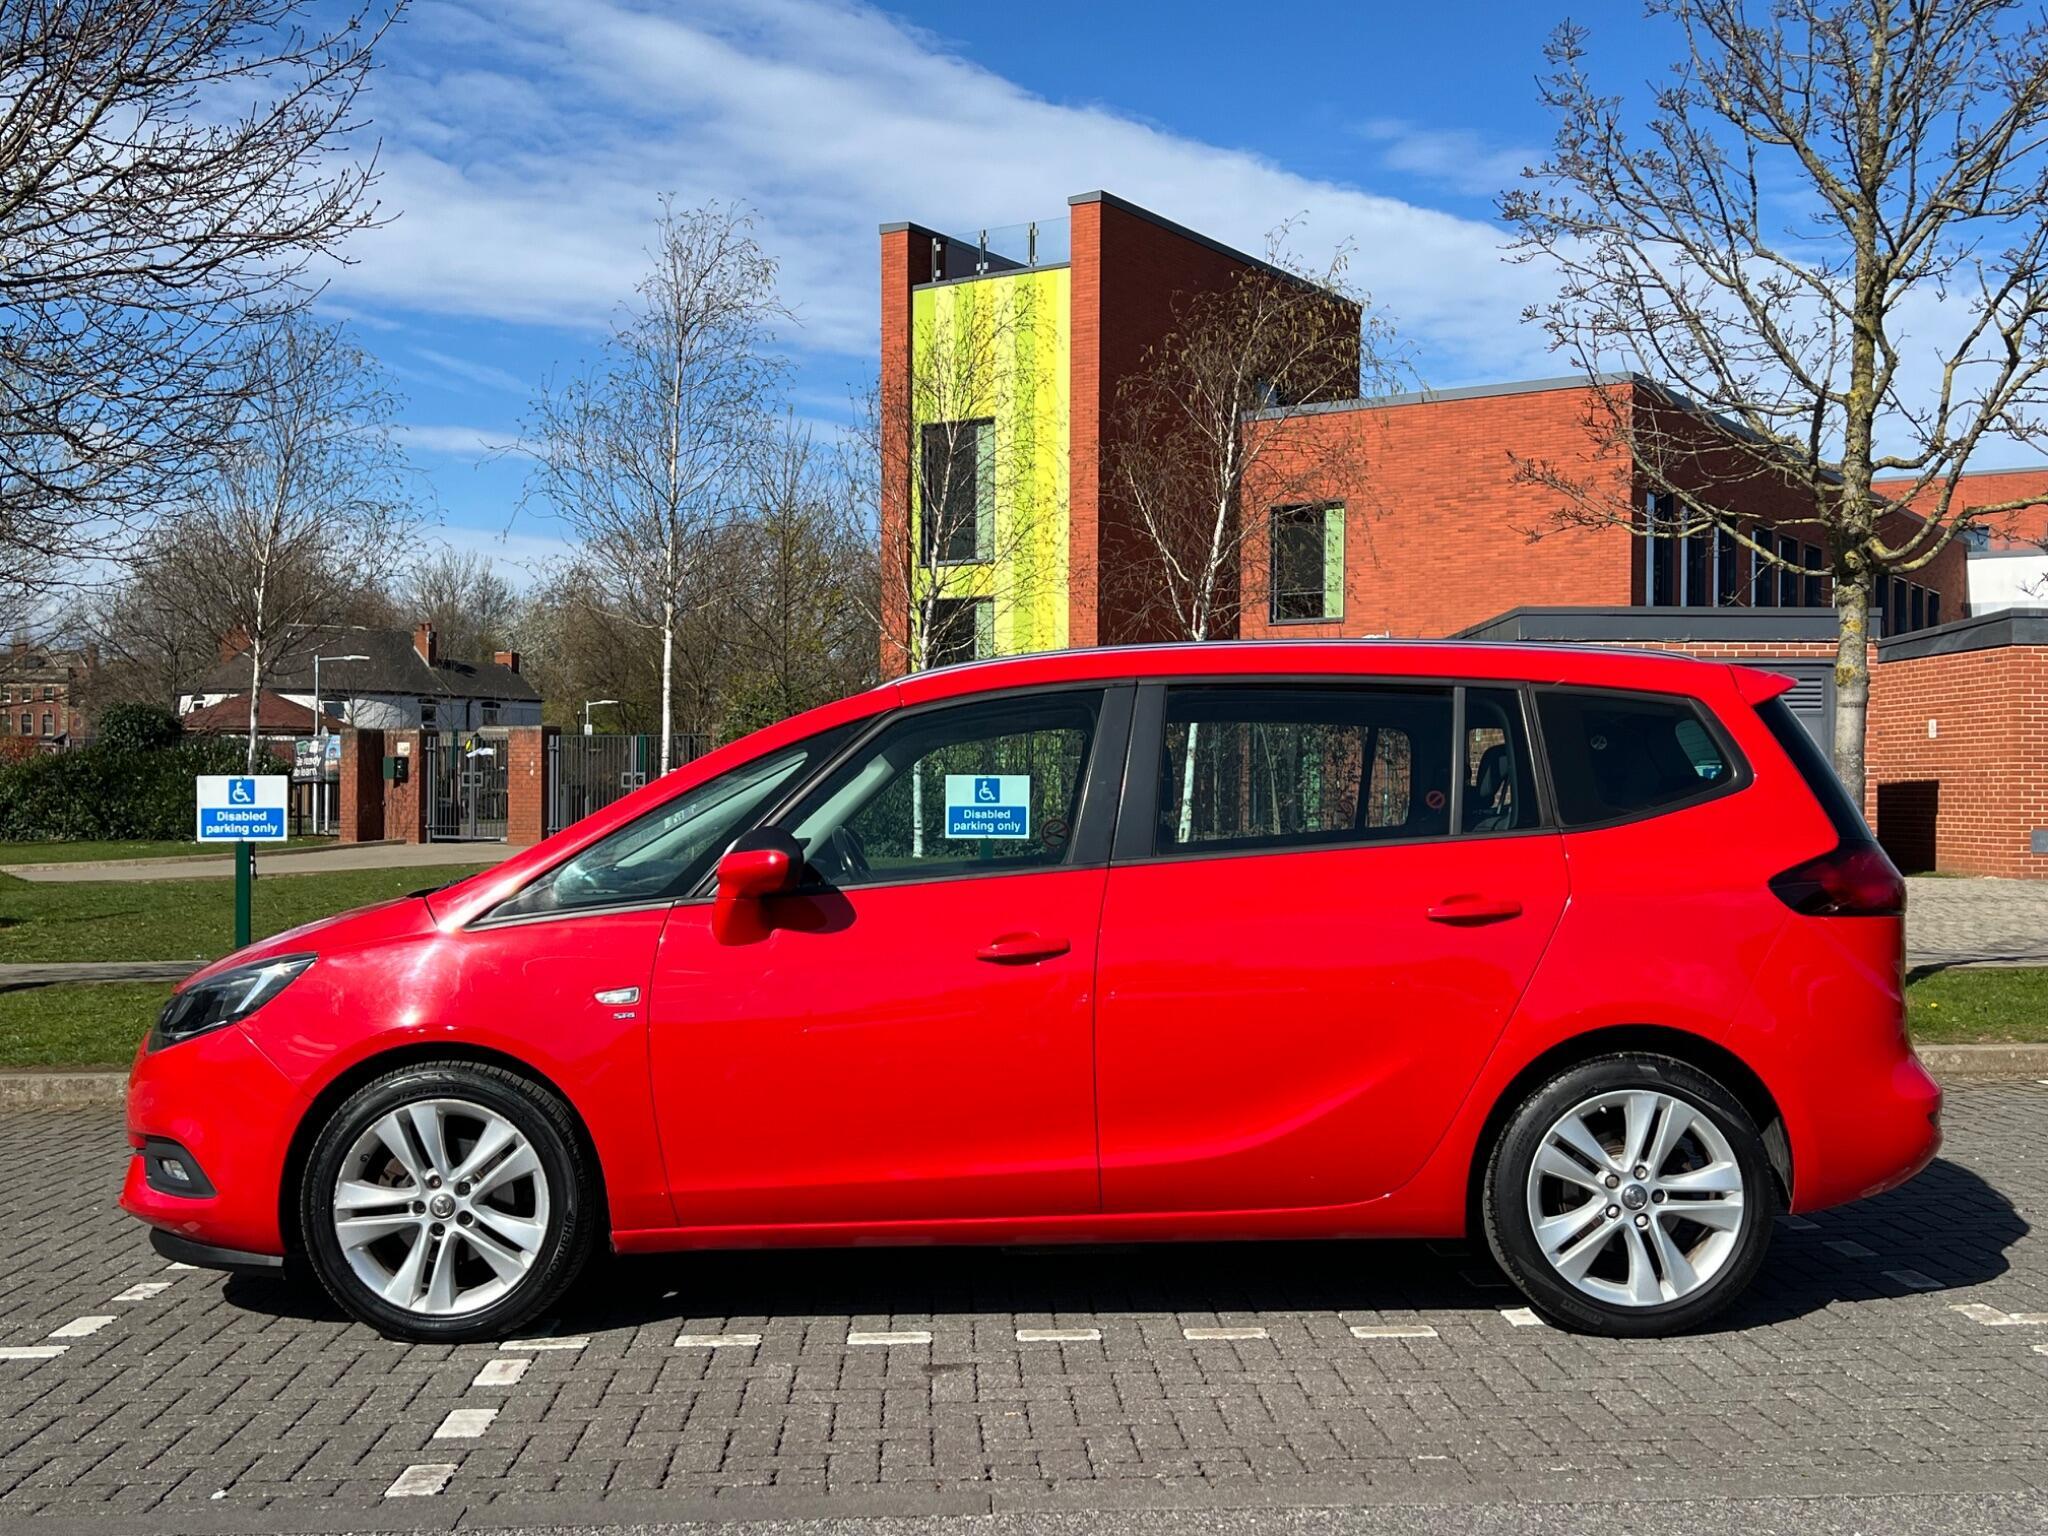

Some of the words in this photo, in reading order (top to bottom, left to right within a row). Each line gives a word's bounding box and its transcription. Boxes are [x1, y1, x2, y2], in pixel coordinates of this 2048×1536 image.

[217, 811, 267, 821] Disabled
[964, 810, 1010, 819] Disabled
[206, 823, 249, 835] parking
[252, 823, 278, 835] only
[953, 821, 994, 832] parking
[997, 821, 1020, 832] only
